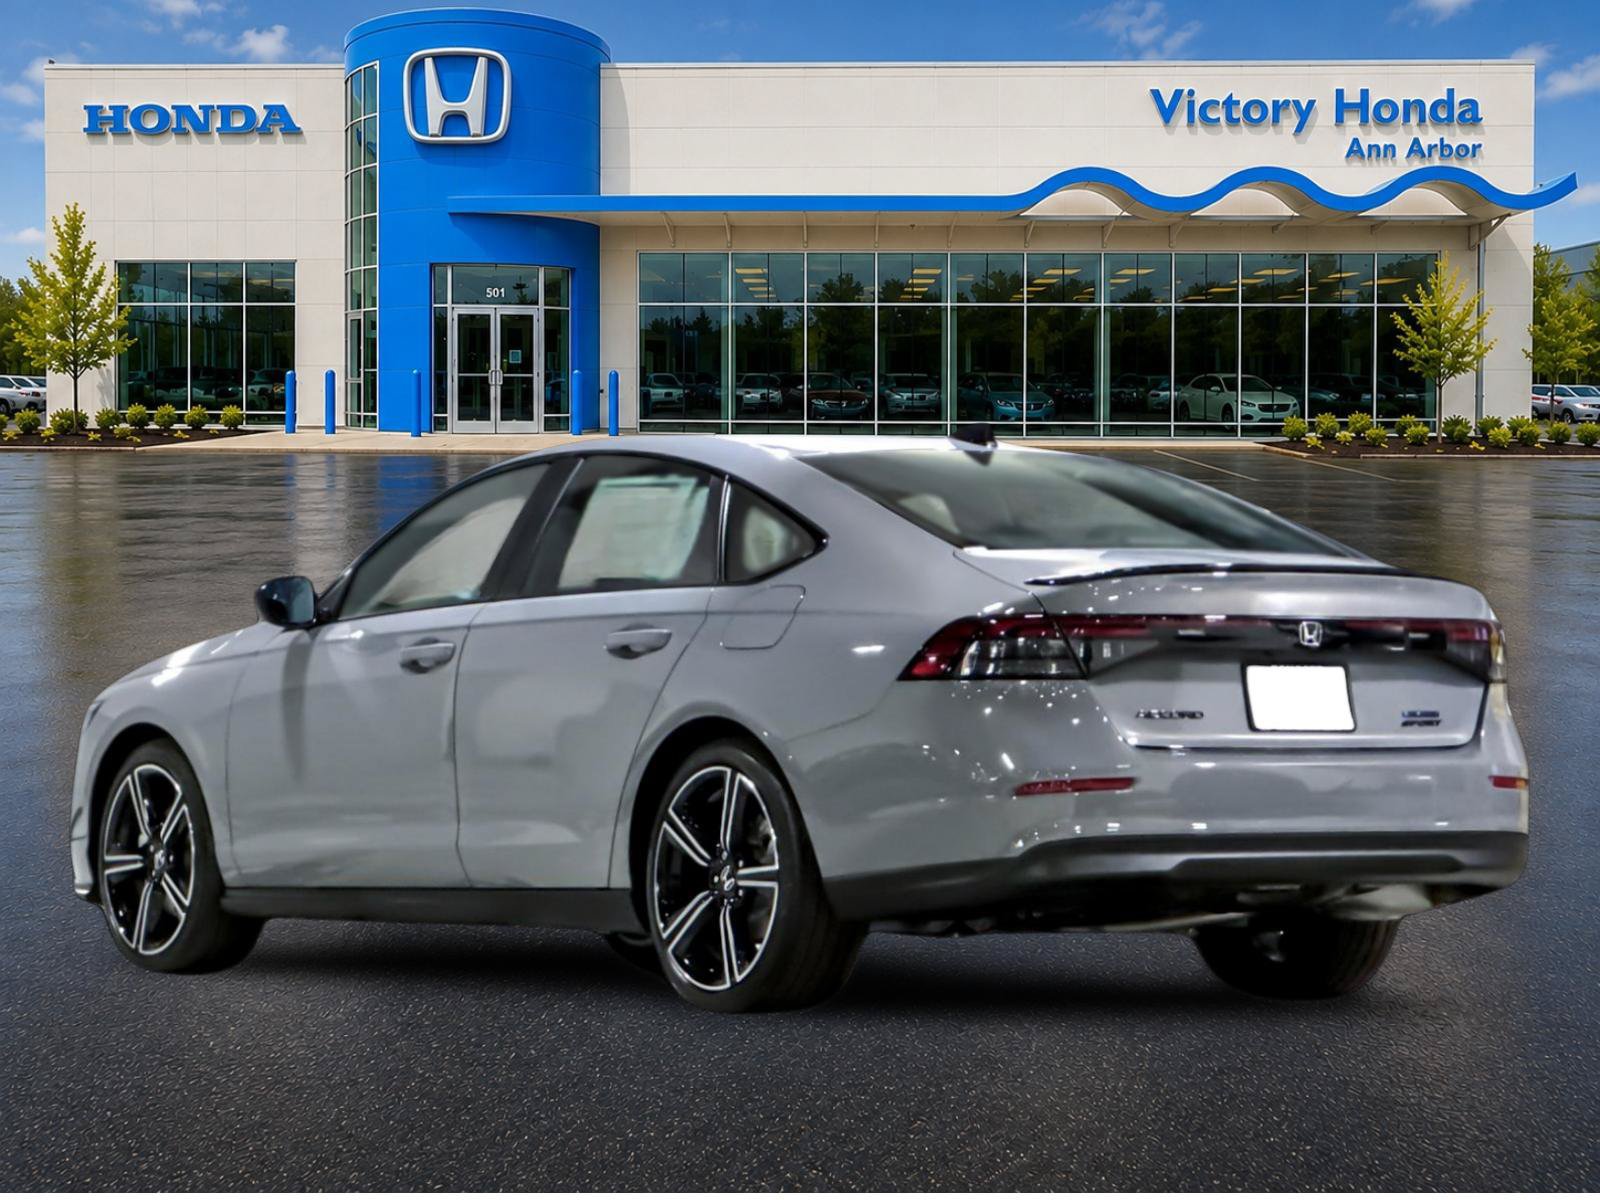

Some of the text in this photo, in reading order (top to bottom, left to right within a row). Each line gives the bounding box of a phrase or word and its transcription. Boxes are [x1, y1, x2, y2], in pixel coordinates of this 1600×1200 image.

[83, 103, 303, 135] HONDA
[1149, 88, 1483, 135] Victory Honda
[1345, 137, 1483, 160] Ann Arbor
[486, 287, 505, 298] 501
